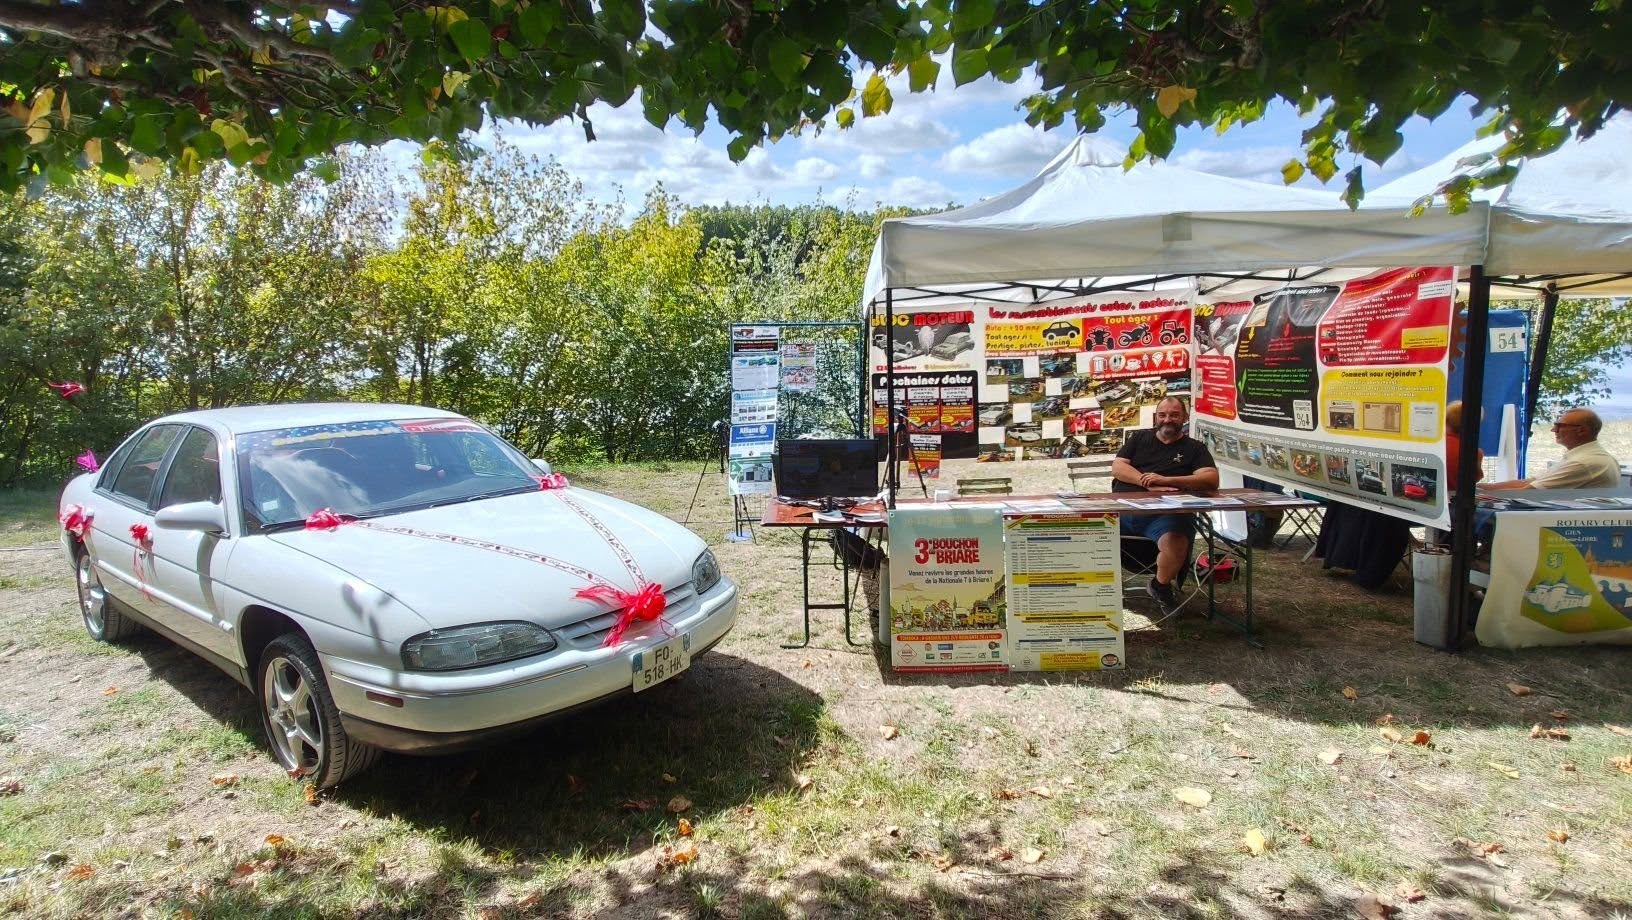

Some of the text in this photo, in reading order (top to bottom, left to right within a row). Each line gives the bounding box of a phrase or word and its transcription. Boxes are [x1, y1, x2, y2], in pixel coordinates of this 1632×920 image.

[914, 311, 975, 326] MOTEUR
[1498, 333, 1518, 350] 54
[879, 374, 973, 387] Pochaines dates
[1385, 370, 1417, 379] rejoindre
[932, 537, 979, 549] BOUCHON
[936, 549, 980, 564] BRIARE
[953, 569, 975, 577] grandes
